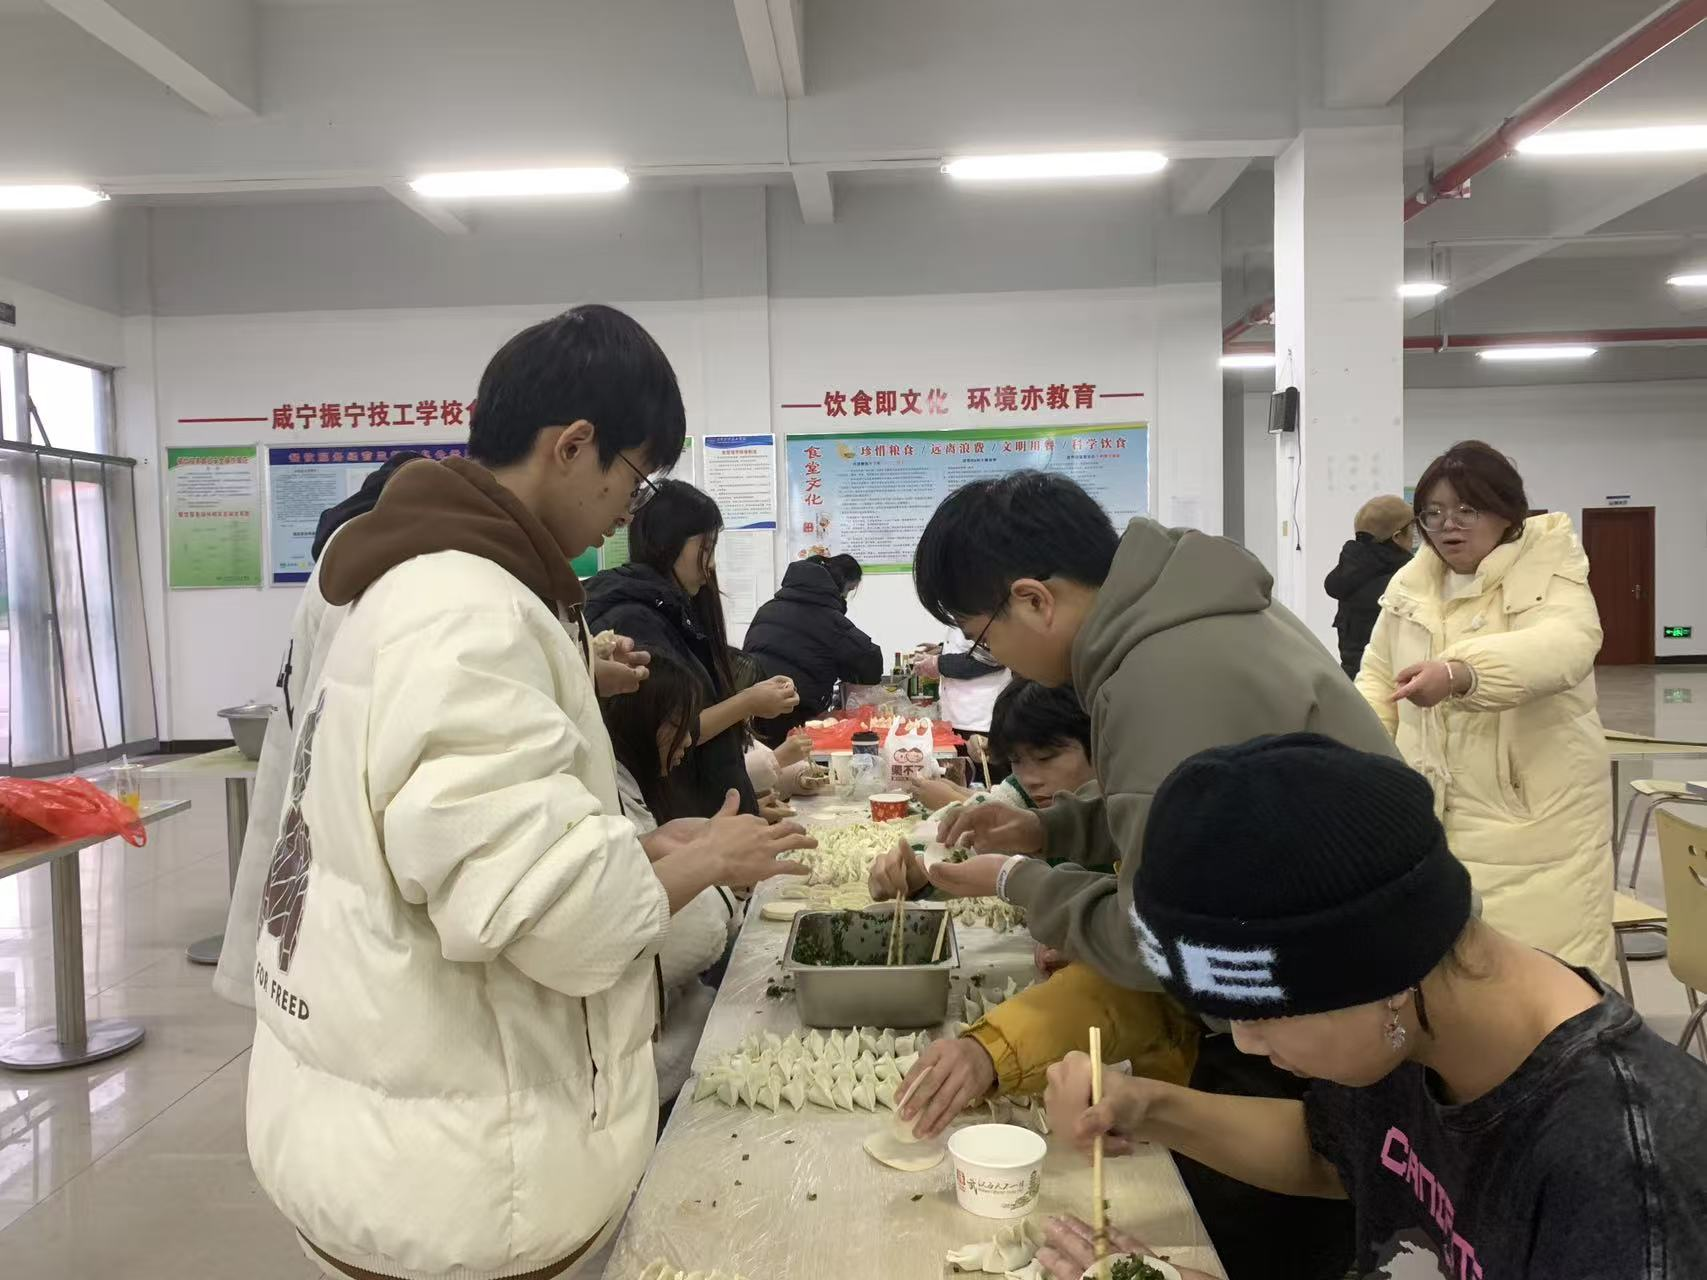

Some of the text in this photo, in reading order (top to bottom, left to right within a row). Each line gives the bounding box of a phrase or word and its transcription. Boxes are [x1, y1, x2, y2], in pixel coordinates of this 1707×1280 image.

[824, 383, 1096, 417] 饮食即文化 环境亦教育
[861, 445, 914, 457] 珍惜粮食
[930, 441, 985, 456] 远离浪费
[1002, 438, 1056, 453] 文明用餐
[1072, 437, 1127, 450] 科学饮食
[803, 446, 823, 506] 食堂文化
[255, 961, 310, 1020] FOR FREED
